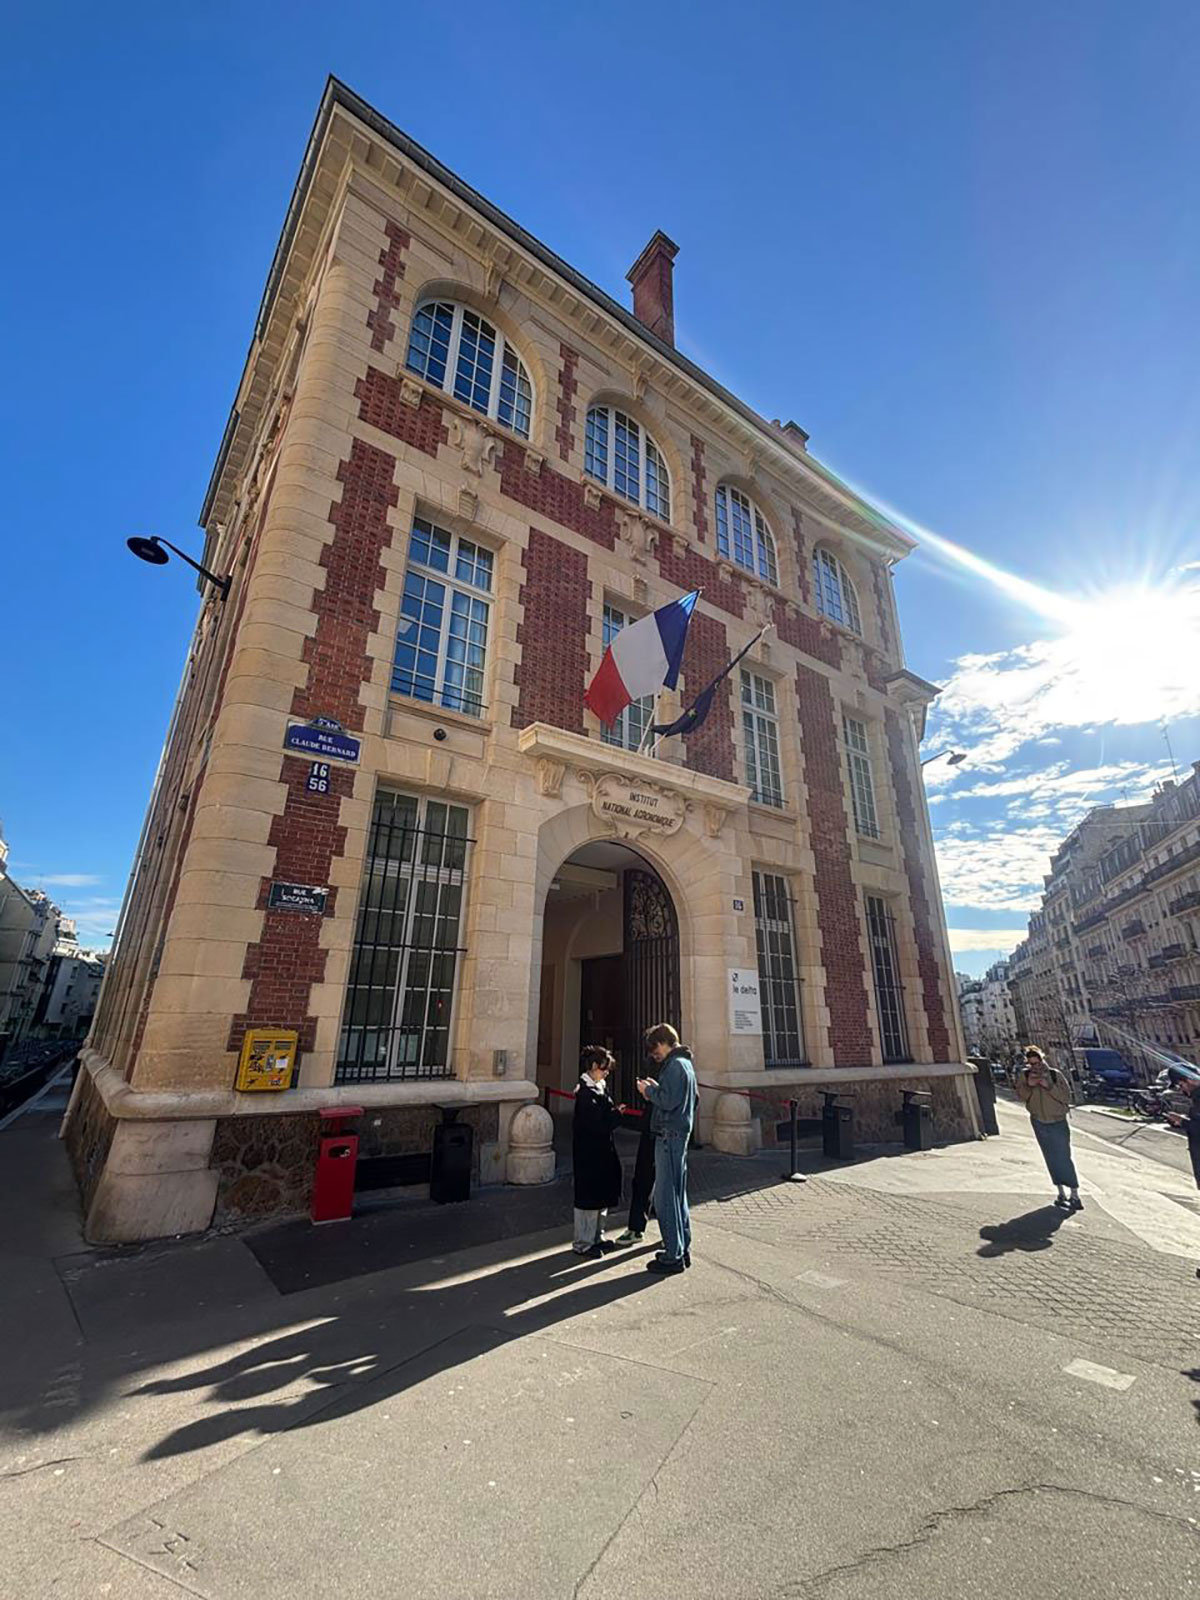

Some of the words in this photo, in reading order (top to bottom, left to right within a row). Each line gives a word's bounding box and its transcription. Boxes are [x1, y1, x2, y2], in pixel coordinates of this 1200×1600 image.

[291, 738, 320, 749] CLAUDE
[321, 745, 356, 758] BERNARD
[312, 763, 328, 777] 16
[308, 778, 328, 792] 56
[629, 792, 659, 807] INSTITUT
[602, 801, 632, 818] NATIONAL
[633, 808, 676, 828] AGRONOMIQUE
[733, 984, 739, 994] le
[740, 985, 757, 995] delta
